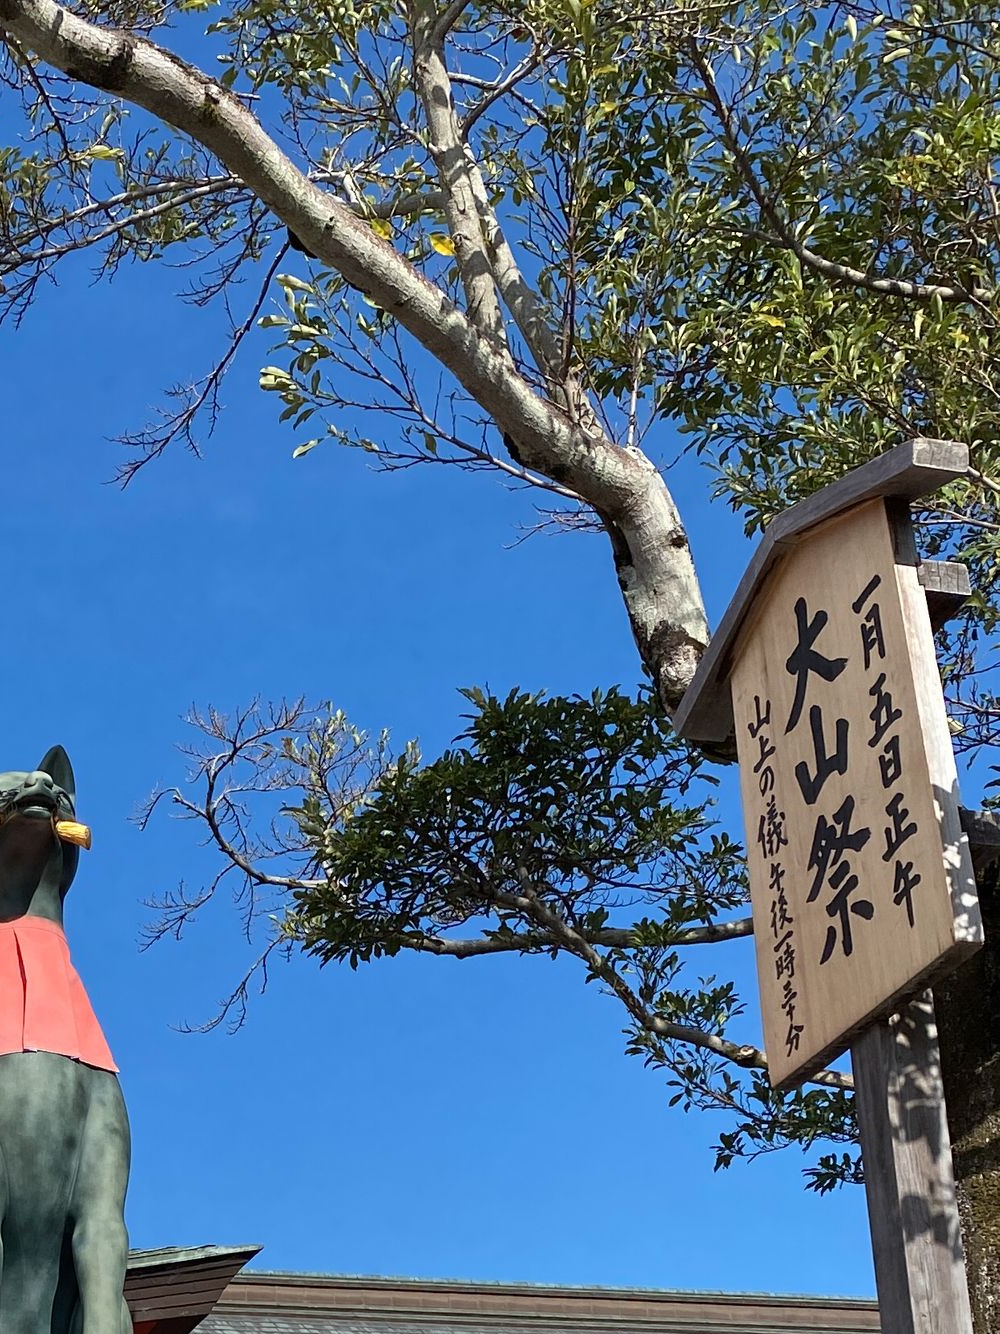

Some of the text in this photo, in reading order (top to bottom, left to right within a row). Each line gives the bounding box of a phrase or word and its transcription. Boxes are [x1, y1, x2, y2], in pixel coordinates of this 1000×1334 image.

[785, 596, 875, 966] 大山祭
[852, 574, 921, 929] 一月五日正午
